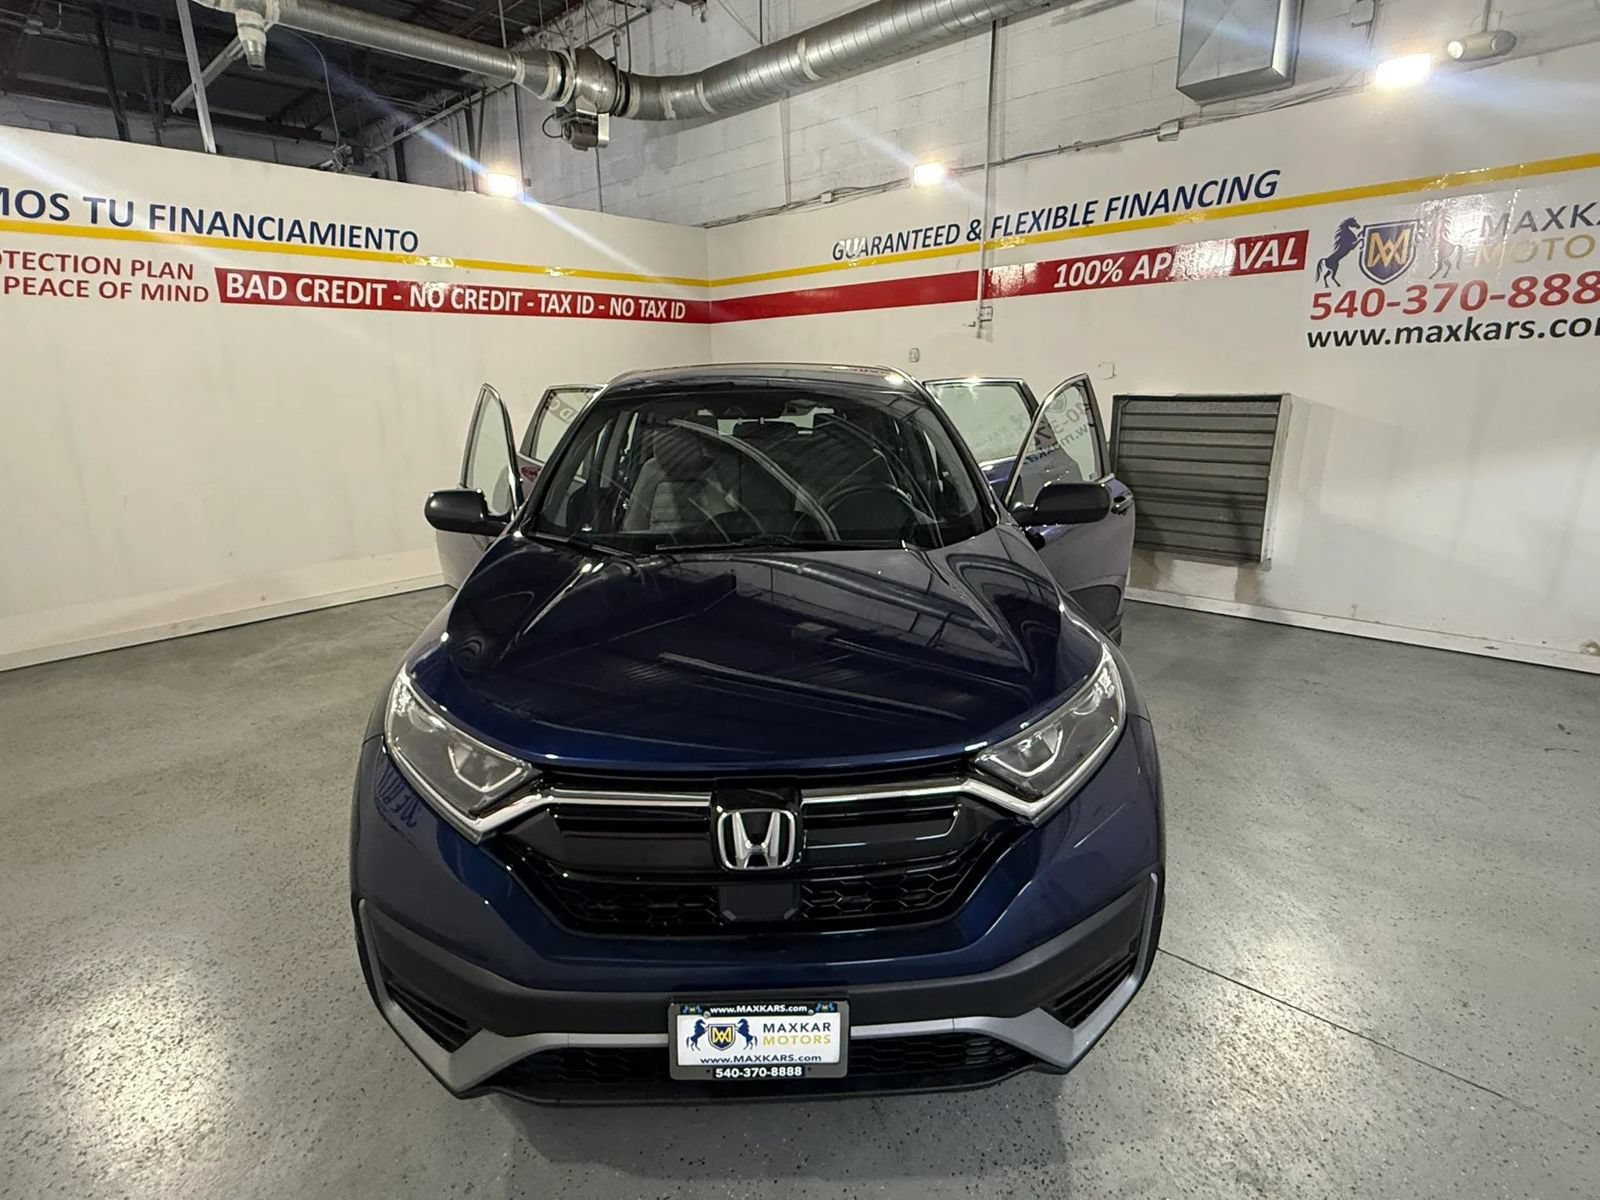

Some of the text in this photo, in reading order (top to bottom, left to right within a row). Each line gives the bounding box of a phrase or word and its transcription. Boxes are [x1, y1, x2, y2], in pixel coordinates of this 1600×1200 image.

[83, 196, 134, 227] TU
[149, 203, 418, 253] FINANCIAMIENTO
[832, 169, 1281, 261] GUARANTEED & FLEXIBLE FINANCING
[1480, 201, 1600, 238] MAXK
[0, 250, 194, 281] TECTION PLAN
[1053, 256, 1126, 289] 100%
[4, 276, 209, 303] PEACE OF MIND
[226, 273, 288, 301] BAD
[295, 277, 388, 307] CREDIT
[410, 283, 445, 309] NO
[451, 287, 523, 312] CREDIT
[537, 293, 572, 314] TAX
[576, 295, 595, 315] ID
[609, 297, 635, 317] NO
[638, 299, 667, 319] TAX
[670, 302, 686, 320] ID
[1307, 316, 1600, 348] www.maxkars.co
[709, 1004, 808, 1014] www.MAXKARS.com
[763, 1022, 831, 1033] MAXKAR
[763, 1034, 831, 1046] MOTORS
[699, 1054, 822, 1064] www.MAXKARS.com
[715, 1066, 803, 1078] 540-370-8888
